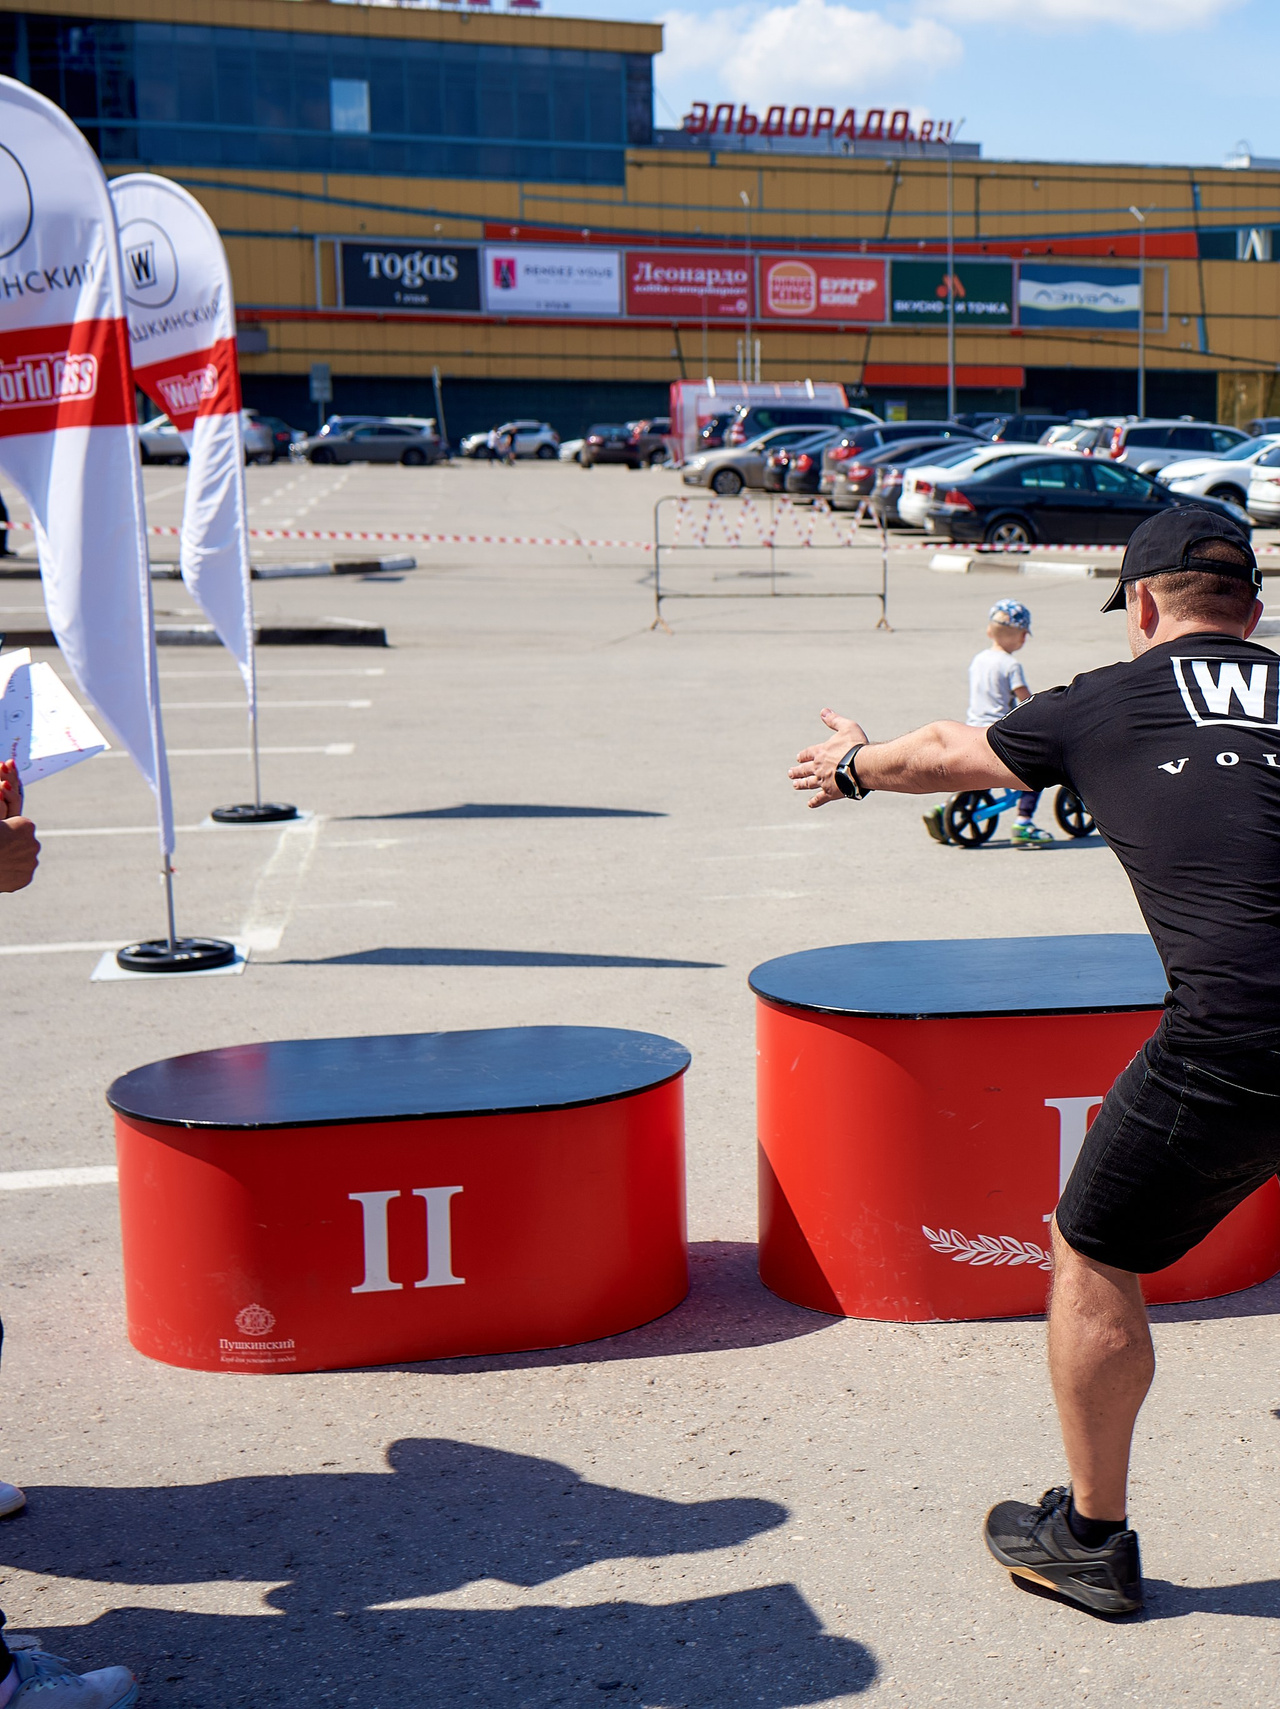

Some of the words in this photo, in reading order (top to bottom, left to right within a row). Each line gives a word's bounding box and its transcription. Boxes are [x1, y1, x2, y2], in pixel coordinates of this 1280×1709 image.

[0, 259, 95, 298] НСКИЙ
[362, 250, 458, 288] Togas
[633, 261, 748, 287] Леонардо
[820, 278, 877, 293] БУРГЕР
[130, 298, 219, 344] ШКИНСКИЙ
[0, 361, 51, 402] orld
[1191, 660, 1269, 719] W
[349, 1185, 466, 1294] II
[219, 1338, 295, 1351] Пушкинский
